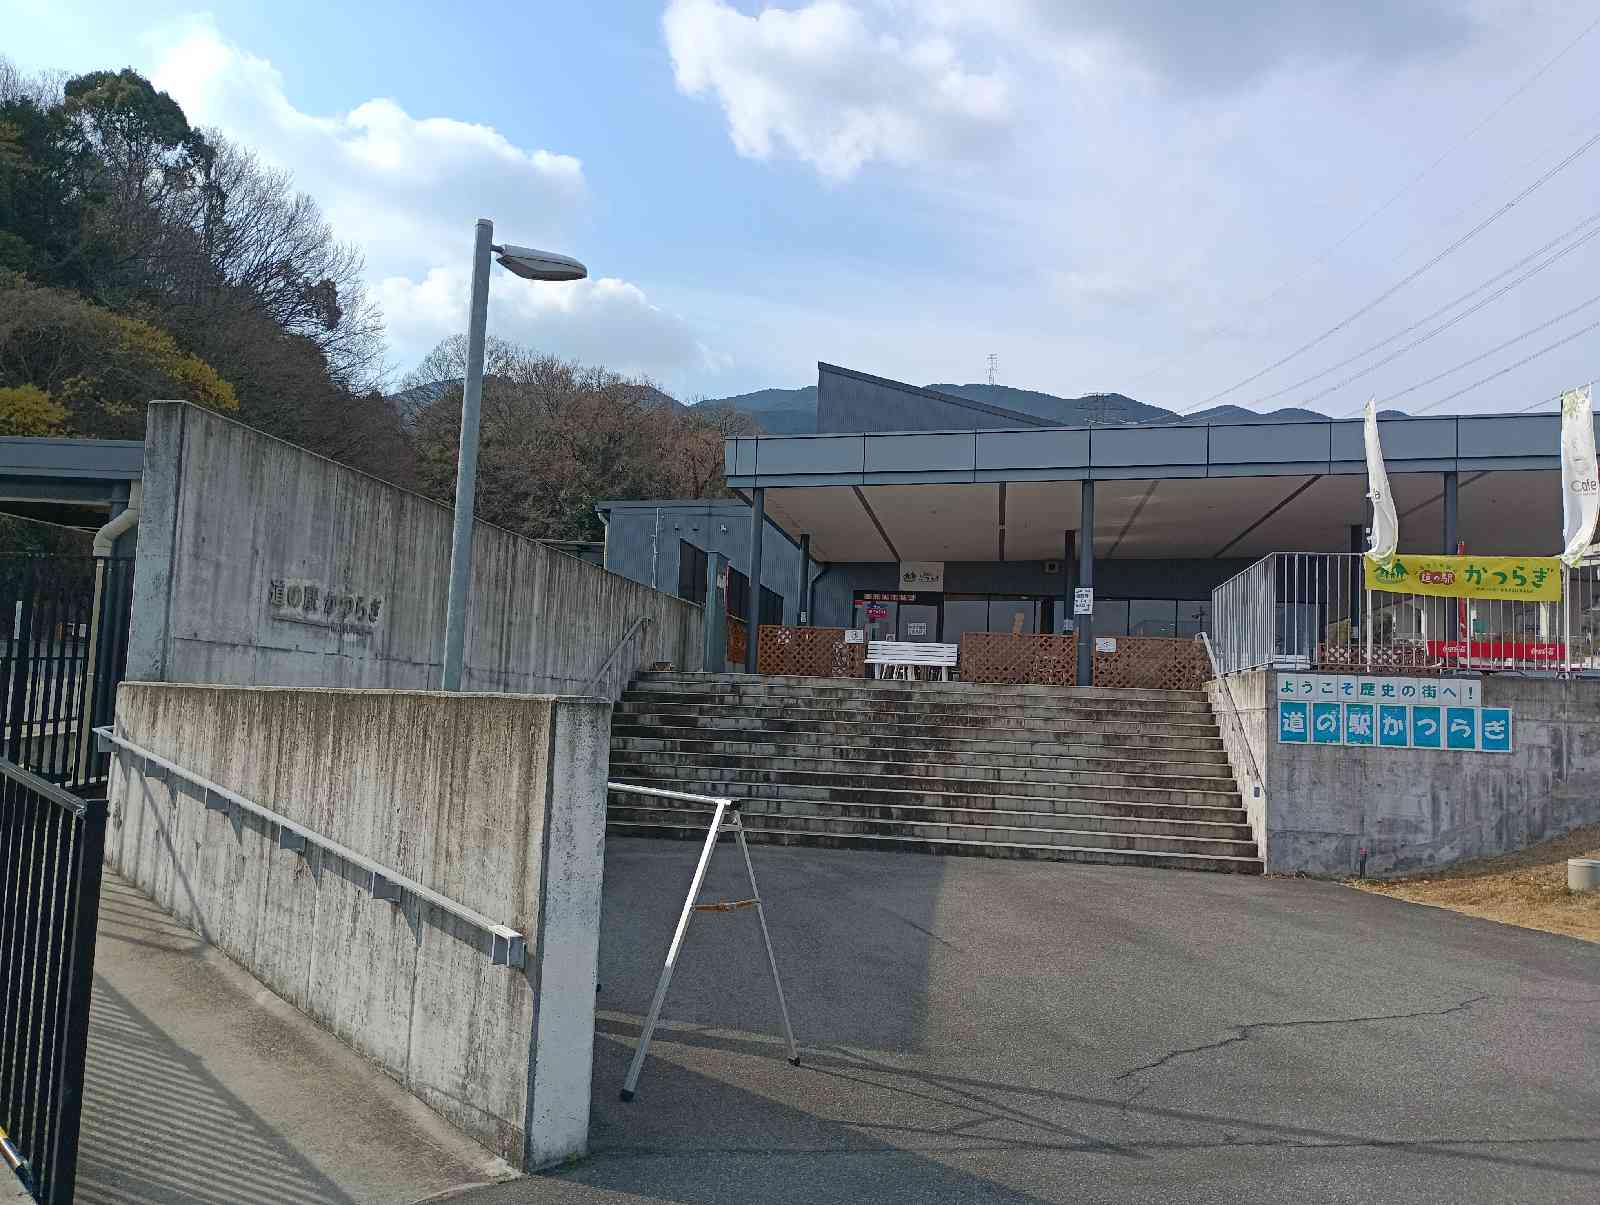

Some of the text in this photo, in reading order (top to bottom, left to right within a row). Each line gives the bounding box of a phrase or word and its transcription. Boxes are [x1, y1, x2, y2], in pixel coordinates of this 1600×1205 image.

[1570, 479, 1598, 494] Cafe
[1464, 564, 1554, 588] かつらぎ
[1282, 711, 1506, 741] 道の駅かつらぎ
